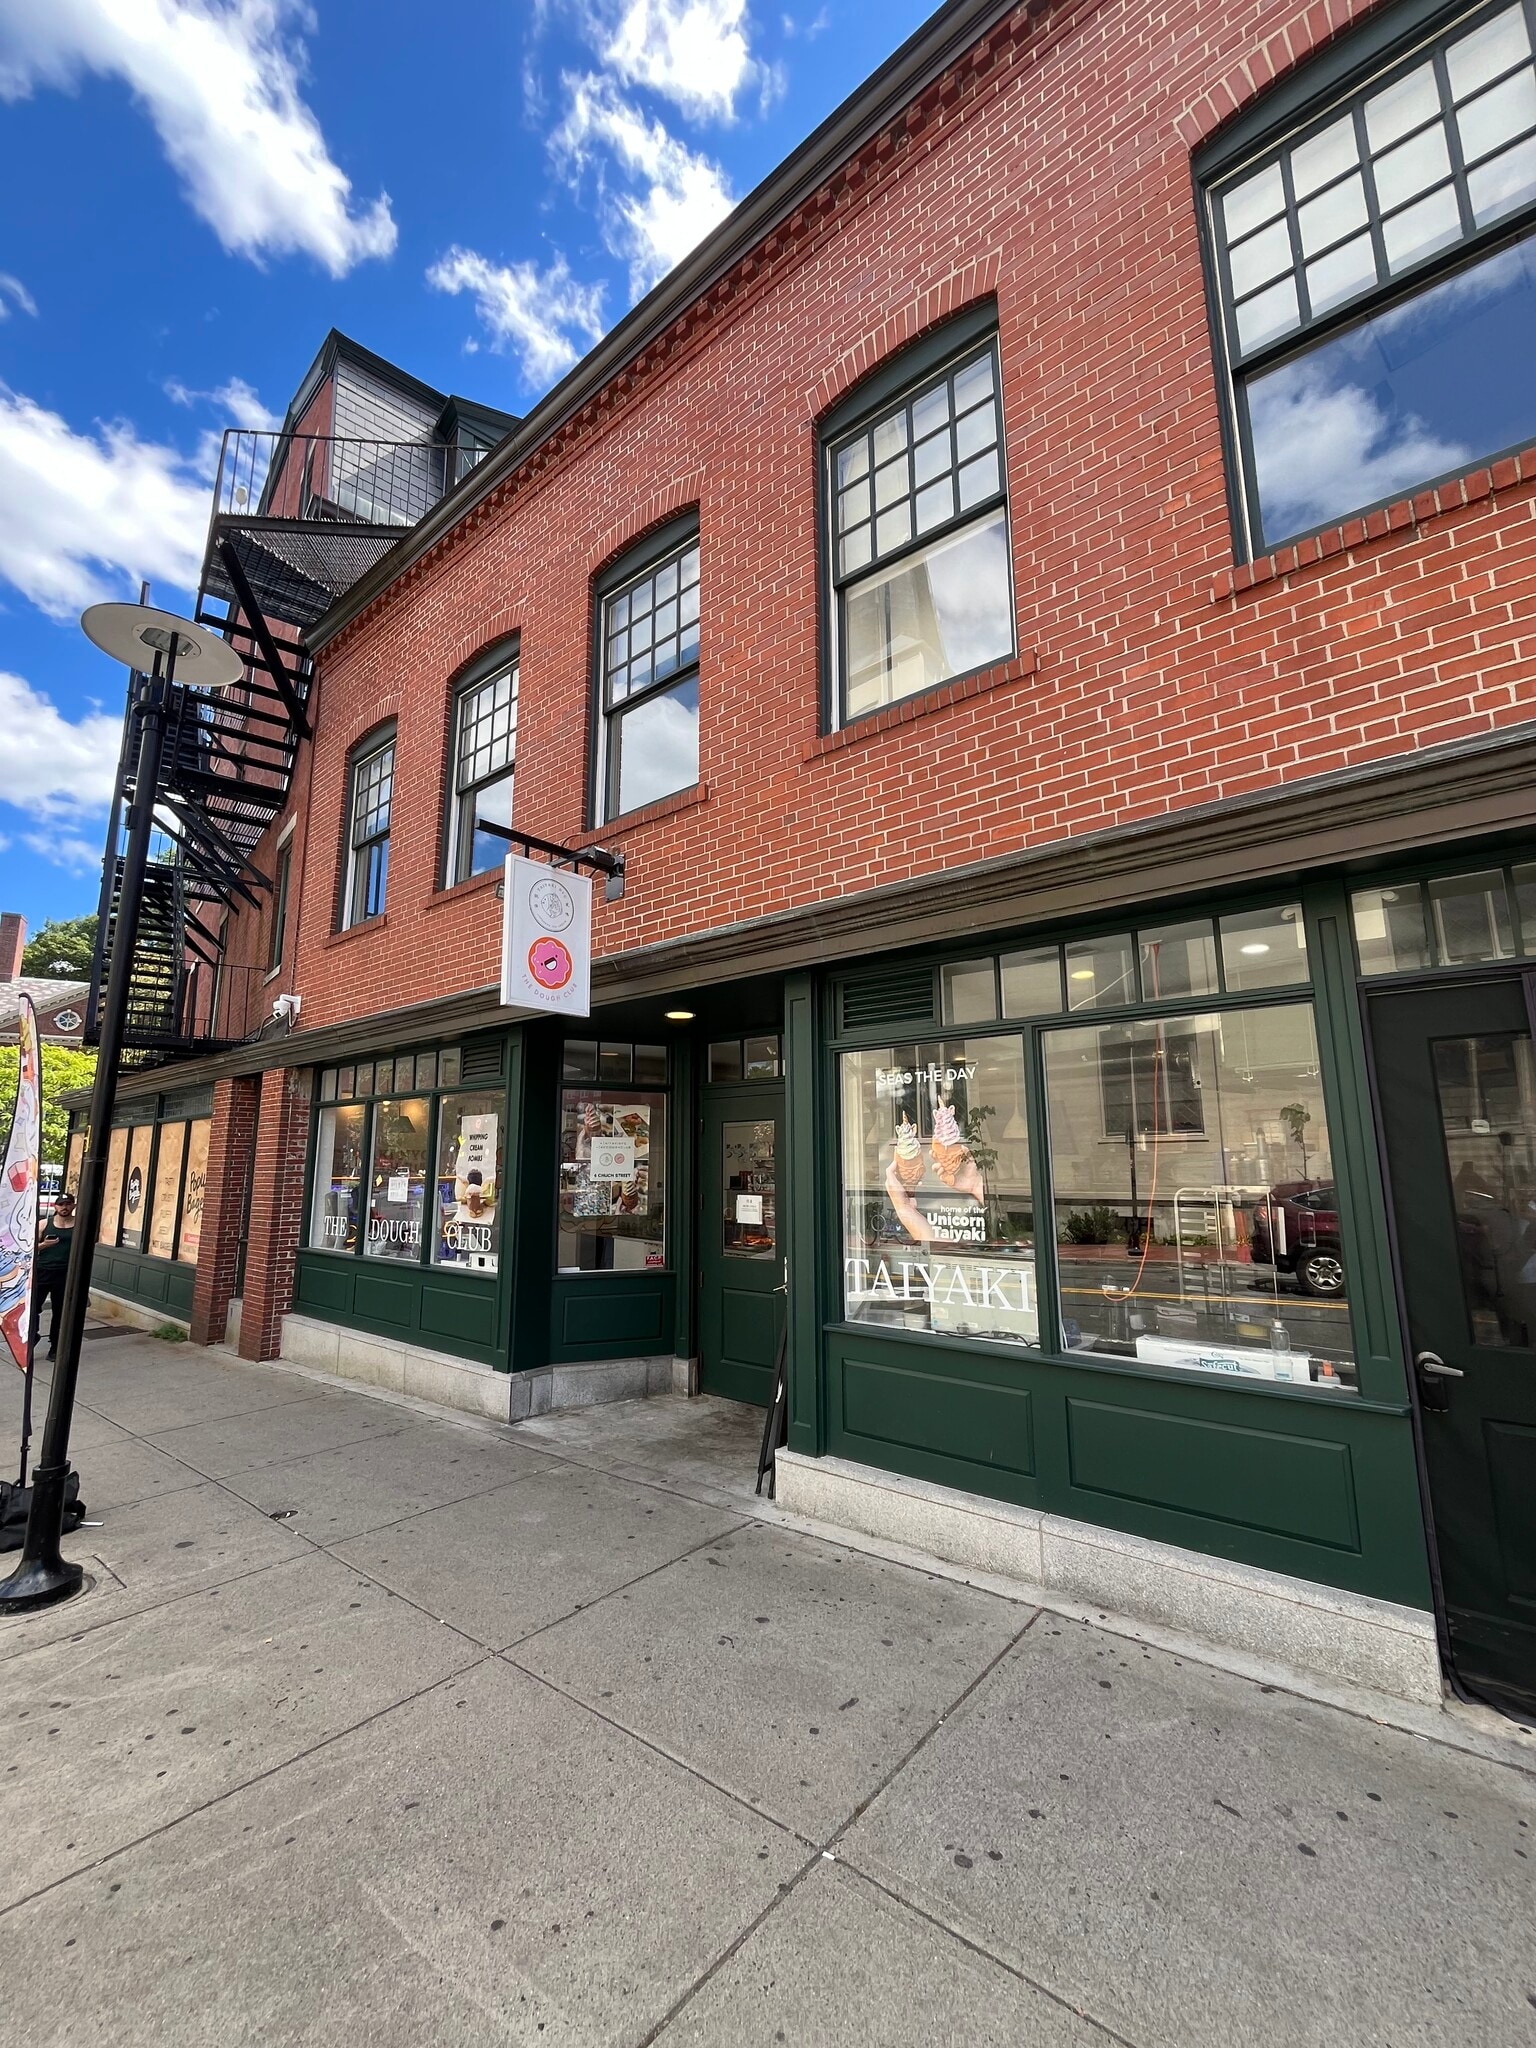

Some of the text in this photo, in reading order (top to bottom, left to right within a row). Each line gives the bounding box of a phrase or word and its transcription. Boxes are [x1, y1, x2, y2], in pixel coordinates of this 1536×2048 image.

[521, 973, 533, 990] THE
[534, 988, 561, 1002] DOUGH
[878, 1066, 976, 1086] SEAS THE DAY
[469, 1133, 488, 1141] WHIPPING
[469, 1144, 483, 1152] CREAM
[940, 1204, 986, 1214] home of the
[926, 1212, 986, 1228] Unicorn
[324, 1215, 492, 1252] THE DOUGH CLUB
[931, 1226, 986, 1243] Taiyaki
[844, 1258, 1035, 1313] TAIYAKI
